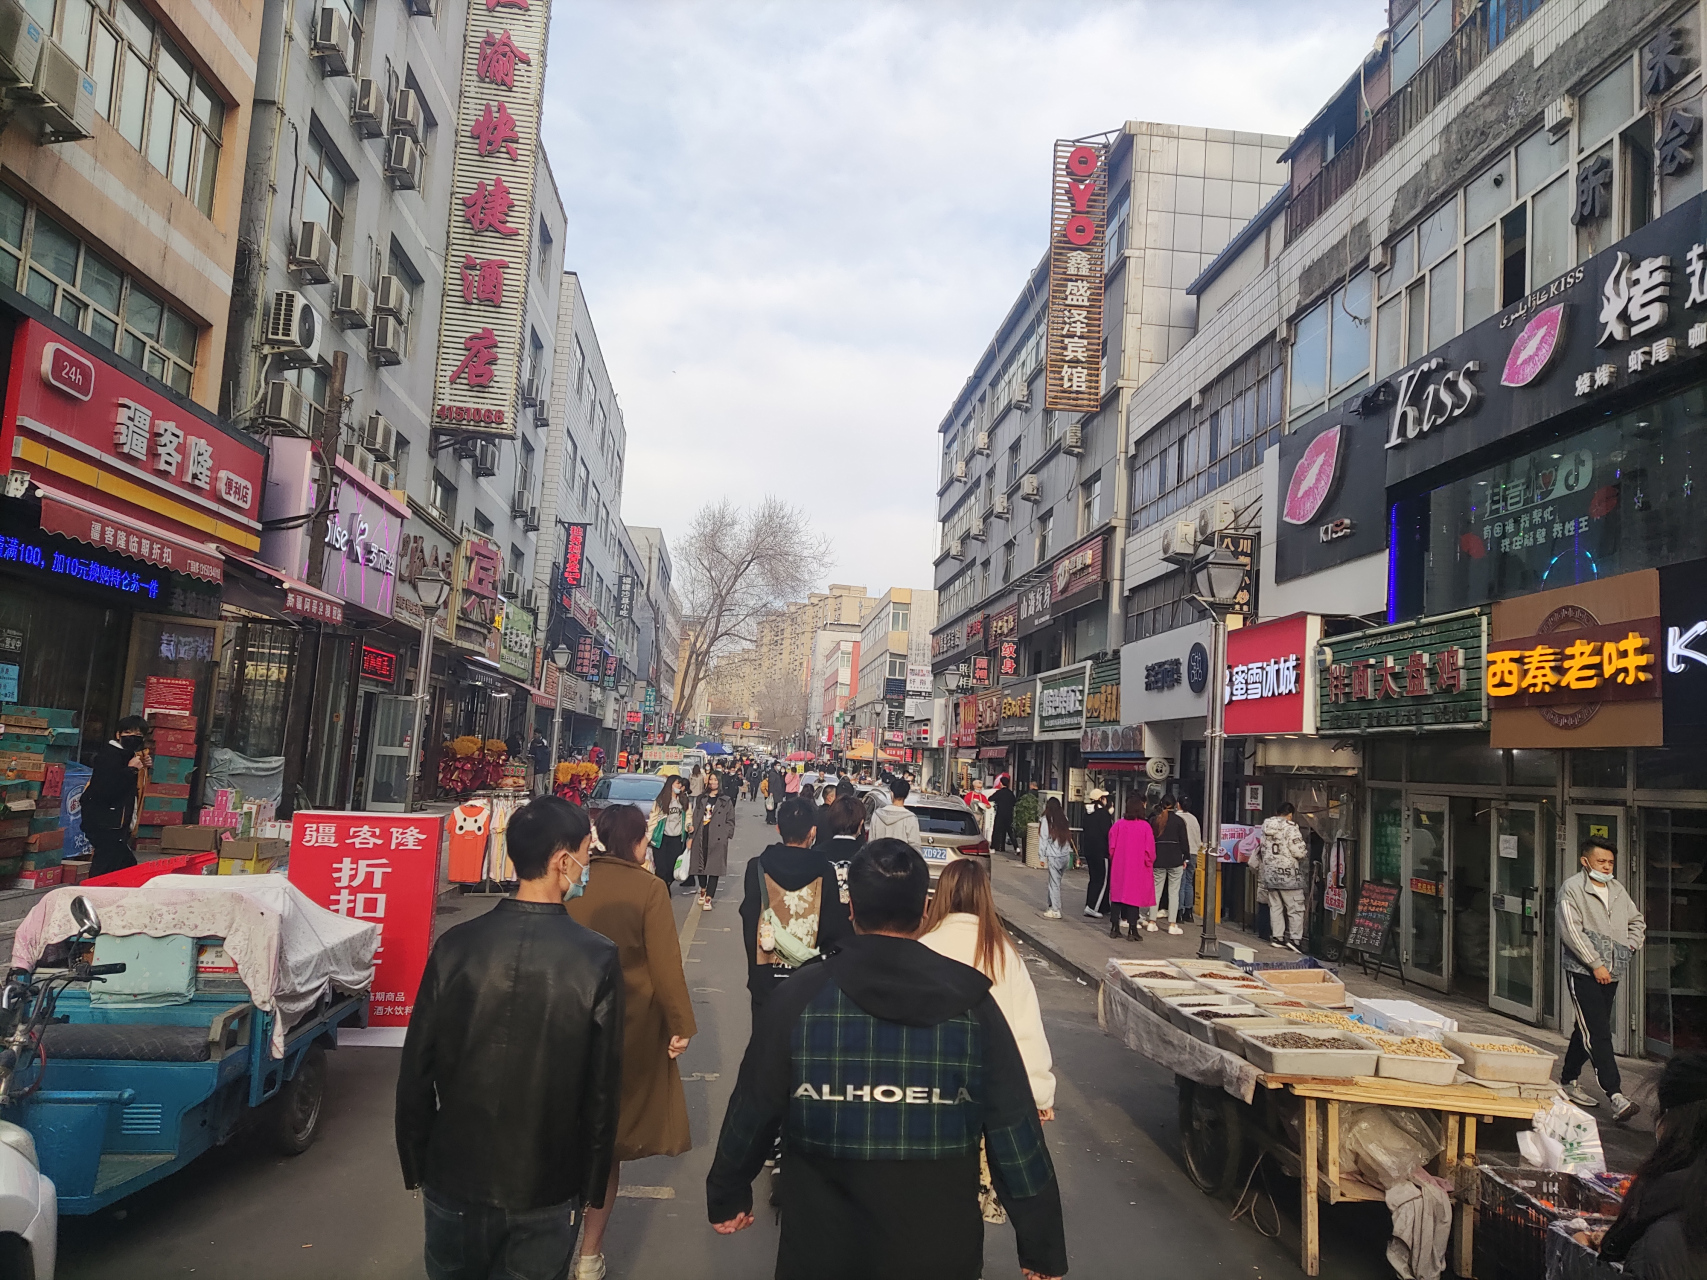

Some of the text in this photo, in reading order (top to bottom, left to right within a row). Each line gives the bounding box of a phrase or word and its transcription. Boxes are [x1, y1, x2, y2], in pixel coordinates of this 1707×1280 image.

[448, 0, 532, 389] 渝快捷酒店
[1066, 147, 1098, 246] OYO
[1549, 266, 1584, 298] KISS
[1061, 250, 1091, 391] 鑫盛泽宾馆
[61, 361, 84, 387] 24h
[1575, 363, 1617, 397] 烧烤
[1628, 338, 1676, 374] 虾尾
[437, 405, 504, 424] 4151066
[1385, 356, 1489, 449] Kiss
[114, 396, 214, 491] 疆客隆
[224, 474, 251, 506] 便利店
[90, 521, 172, 564] 疆客隆临期折扣
[619, 576, 635, 617] 福建沙县小吃
[1020, 582, 1051, 620] 山海纹身
[959, 664, 971, 688] 照相
[1001, 642, 1017, 674] 纹身
[1232, 654, 1299, 701] 蜜雪冰城
[1328, 646, 1466, 703] 拌面大盘鸡
[1487, 632, 1655, 697] 西秦老味
[302, 823, 428, 851] 疆客隆
[373, 1005, 414, 1016] 酒水饮料
[793, 1083, 973, 1104] ALHOELA
